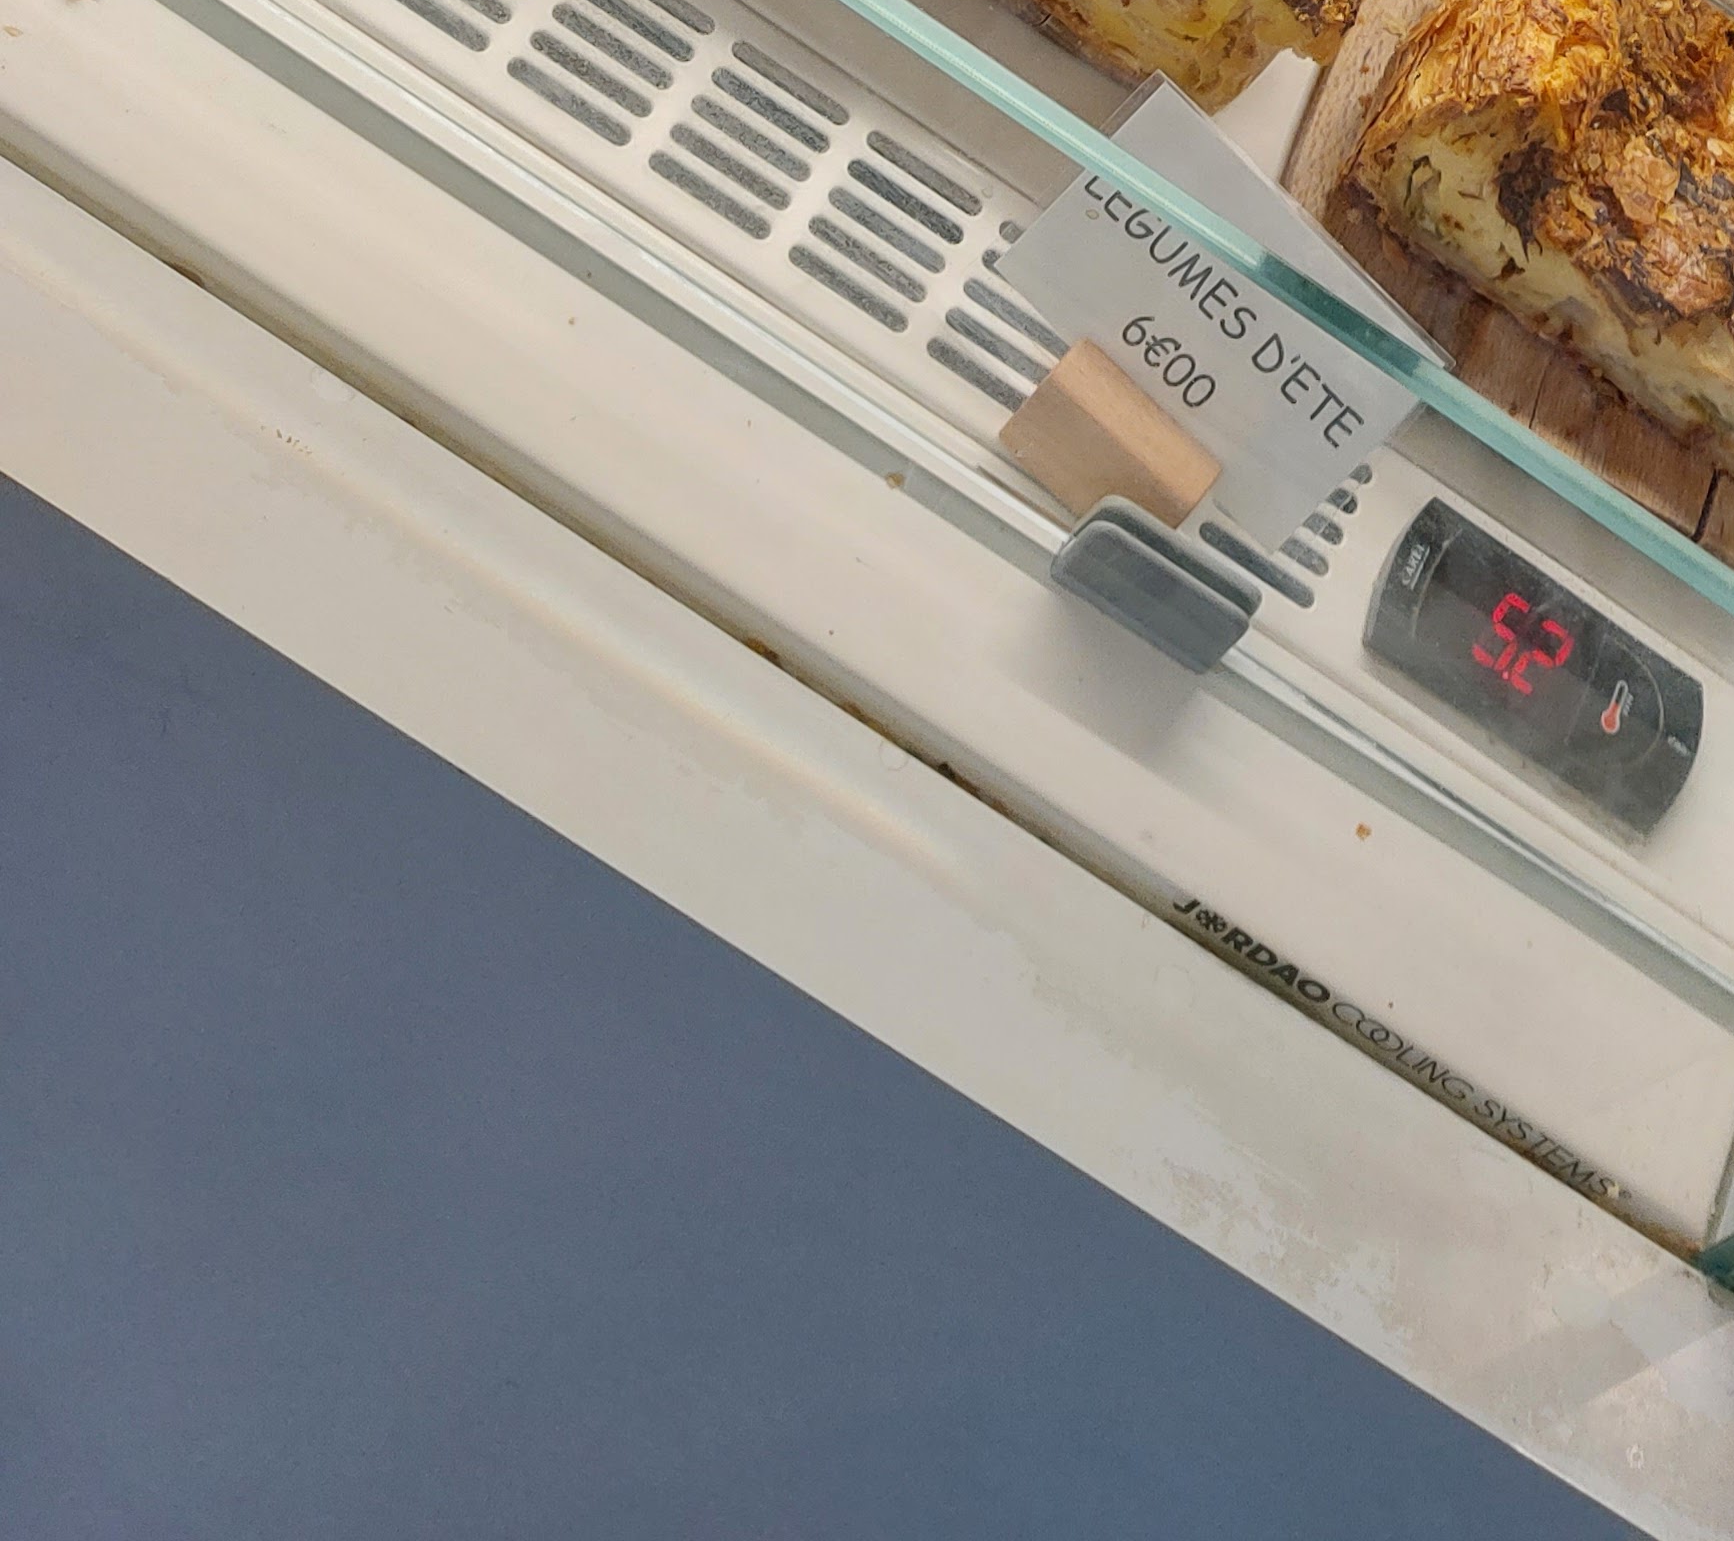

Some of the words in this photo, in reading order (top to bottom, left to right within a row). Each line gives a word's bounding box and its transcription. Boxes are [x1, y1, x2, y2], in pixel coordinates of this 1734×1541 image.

[1121, 316, 1217, 408] 6€00
[1251, 332, 1365, 449] D'ETE
[1472, 592, 1575, 696] 5.2
[1331, 1002, 1475, 1101] COOLING
